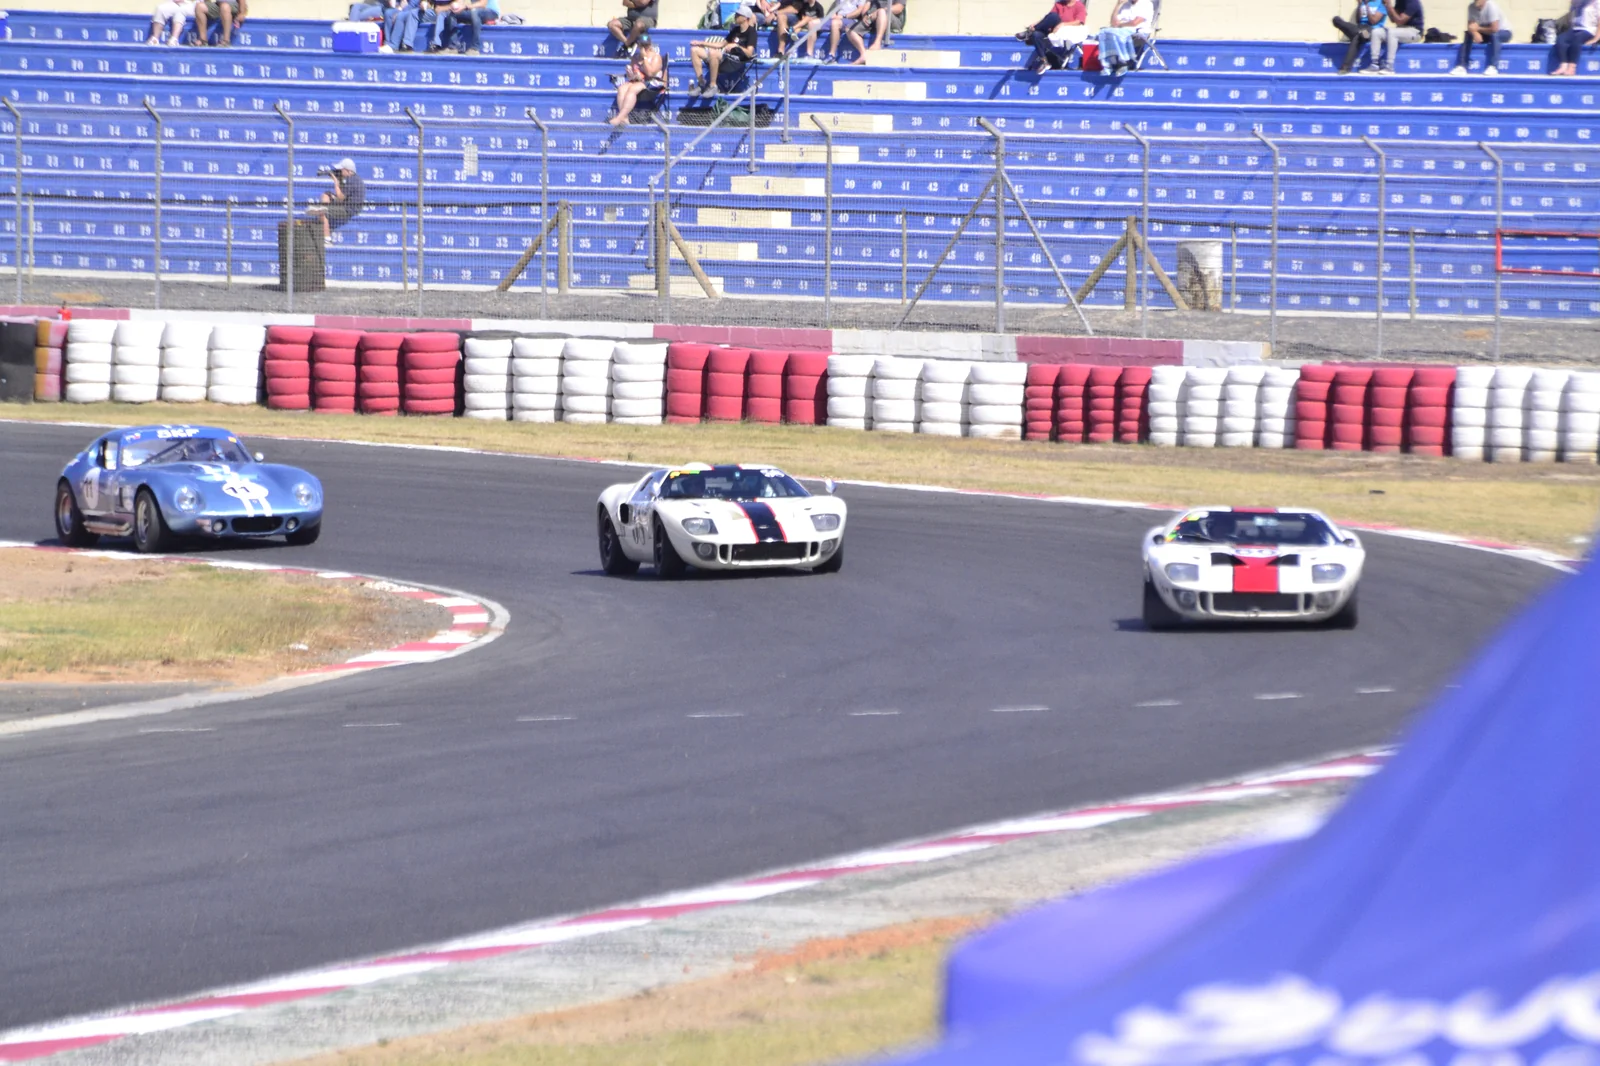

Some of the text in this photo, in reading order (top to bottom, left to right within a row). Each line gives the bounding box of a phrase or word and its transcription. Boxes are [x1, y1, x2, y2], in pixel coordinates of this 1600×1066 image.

[30, 27, 36, 38] 7
[82, 29, 89, 39] 9
[107, 30, 118, 40] 10
[134, 30, 143, 41] 11
[240, 33, 251, 45] 15
[267, 35, 278, 46] 16
[294, 36, 304, 47] 17
[483, 42, 494, 53] 24
[511, 42, 522, 54] 25
[538, 43, 549, 54] 26
[563, 43, 574, 54] 27
[676, 47, 685, 57] 31
[760, 49, 770, 59] 34
[842, 51, 853, 60] 37
[981, 52, 992, 61] 39
[1011, 52, 1021, 62] 40
[20, 58, 27, 69] 8
[47, 59, 54, 69] 9
[72, 60, 83, 70] 10
[98, 60, 109, 71] 11
[1177, 56, 1188, 65] 46
[126, 61, 137, 72] 12
[153, 62, 163, 73] 13
[180, 63, 189, 74] 14
[206, 64, 217, 75] 15
[233, 65, 244, 76] 16
[260, 65, 270, 77] 17
[287, 67, 297, 78] 18
[314, 67, 324, 79] 19
[341, 69, 353, 80] 20
[367, 70, 379, 81] 21
[395, 71, 406, 81] 22
[421, 72, 432, 82] 23
[450, 72, 460, 83] 24
[476, 72, 487, 84] 25
[504, 73, 514, 84] 26
[529, 74, 540, 85] 27
[558, 75, 569, 86] 28
[584, 76, 596, 87] 29
[668, 77, 679, 87] 32
[807, 81, 817, 90] 37
[946, 85, 957, 93] 39
[974, 85, 984, 94] 40
[1001, 85, 1010, 95] 41
[1030, 86, 1039, 95] 42
[1057, 87, 1067, 96] 43
[1084, 87, 1094, 96] 44
[1113, 87, 1124, 97] 45
[1143, 88, 1153, 97] 46
[1172, 88, 1181, 97] 47
[65, 92, 75, 103] 11
[91, 92, 101, 104] 12
[197, 97, 208, 108] 16
[225, 98, 235, 109] 17
[252, 99, 264, 110] 18
[333, 101, 344, 112] 21
[389, 102, 399, 113] 23
[414, 104, 426, 114] 24
[442, 105, 454, 116] 25
[469, 106, 481, 116] 26
[495, 106, 506, 117] 27
[580, 108, 591, 117] 30
[774, 113, 784, 123] 37
[912, 117, 922, 126] 39
[939, 118, 950, 127] 40
[995, 118, 1006, 128] 42
[2, 121, 13, 132] 10
[29, 122, 39, 133] 11
[82, 124, 92, 135] 13
[1052, 120, 1063, 129] 44
[1079, 120, 1090, 129] 45
[1137, 122, 1148, 132] 47
[1162, 122, 1172, 131] 48
[164, 128, 174, 137] 16
[245, 130, 256, 140] 19
[273, 131, 284, 142] 20
[299, 131, 308, 143] 21
[408, 136, 420, 147] 25
[435, 136, 447, 146] 26
[517, 138, 528, 149] 29
[655, 142, 665, 152] 34
[711, 143, 721, 153] 36
[739, 144, 749, 154] 37
[47, 155, 58, 167] 13
[74, 156, 84, 168] 14
[129, 159, 139, 170] 16
[183, 161, 193, 172] 18
[208, 162, 219, 173] 19
[237, 163, 249, 174] 20
[482, 171, 494, 182] 29
[511, 172, 522, 183] 30
[621, 175, 632, 184] 34
[677, 176, 687, 185] 36
[705, 177, 714, 186] 37
[845, 179, 855, 189] 39
[872, 180, 882, 189] 40
[901, 181, 909, 190] 41
[928, 182, 938, 191] 42
[1070, 187, 1079, 196] 47
[1156, 188, 1167, 197] 50
[84, 478, 93, 498] 11
